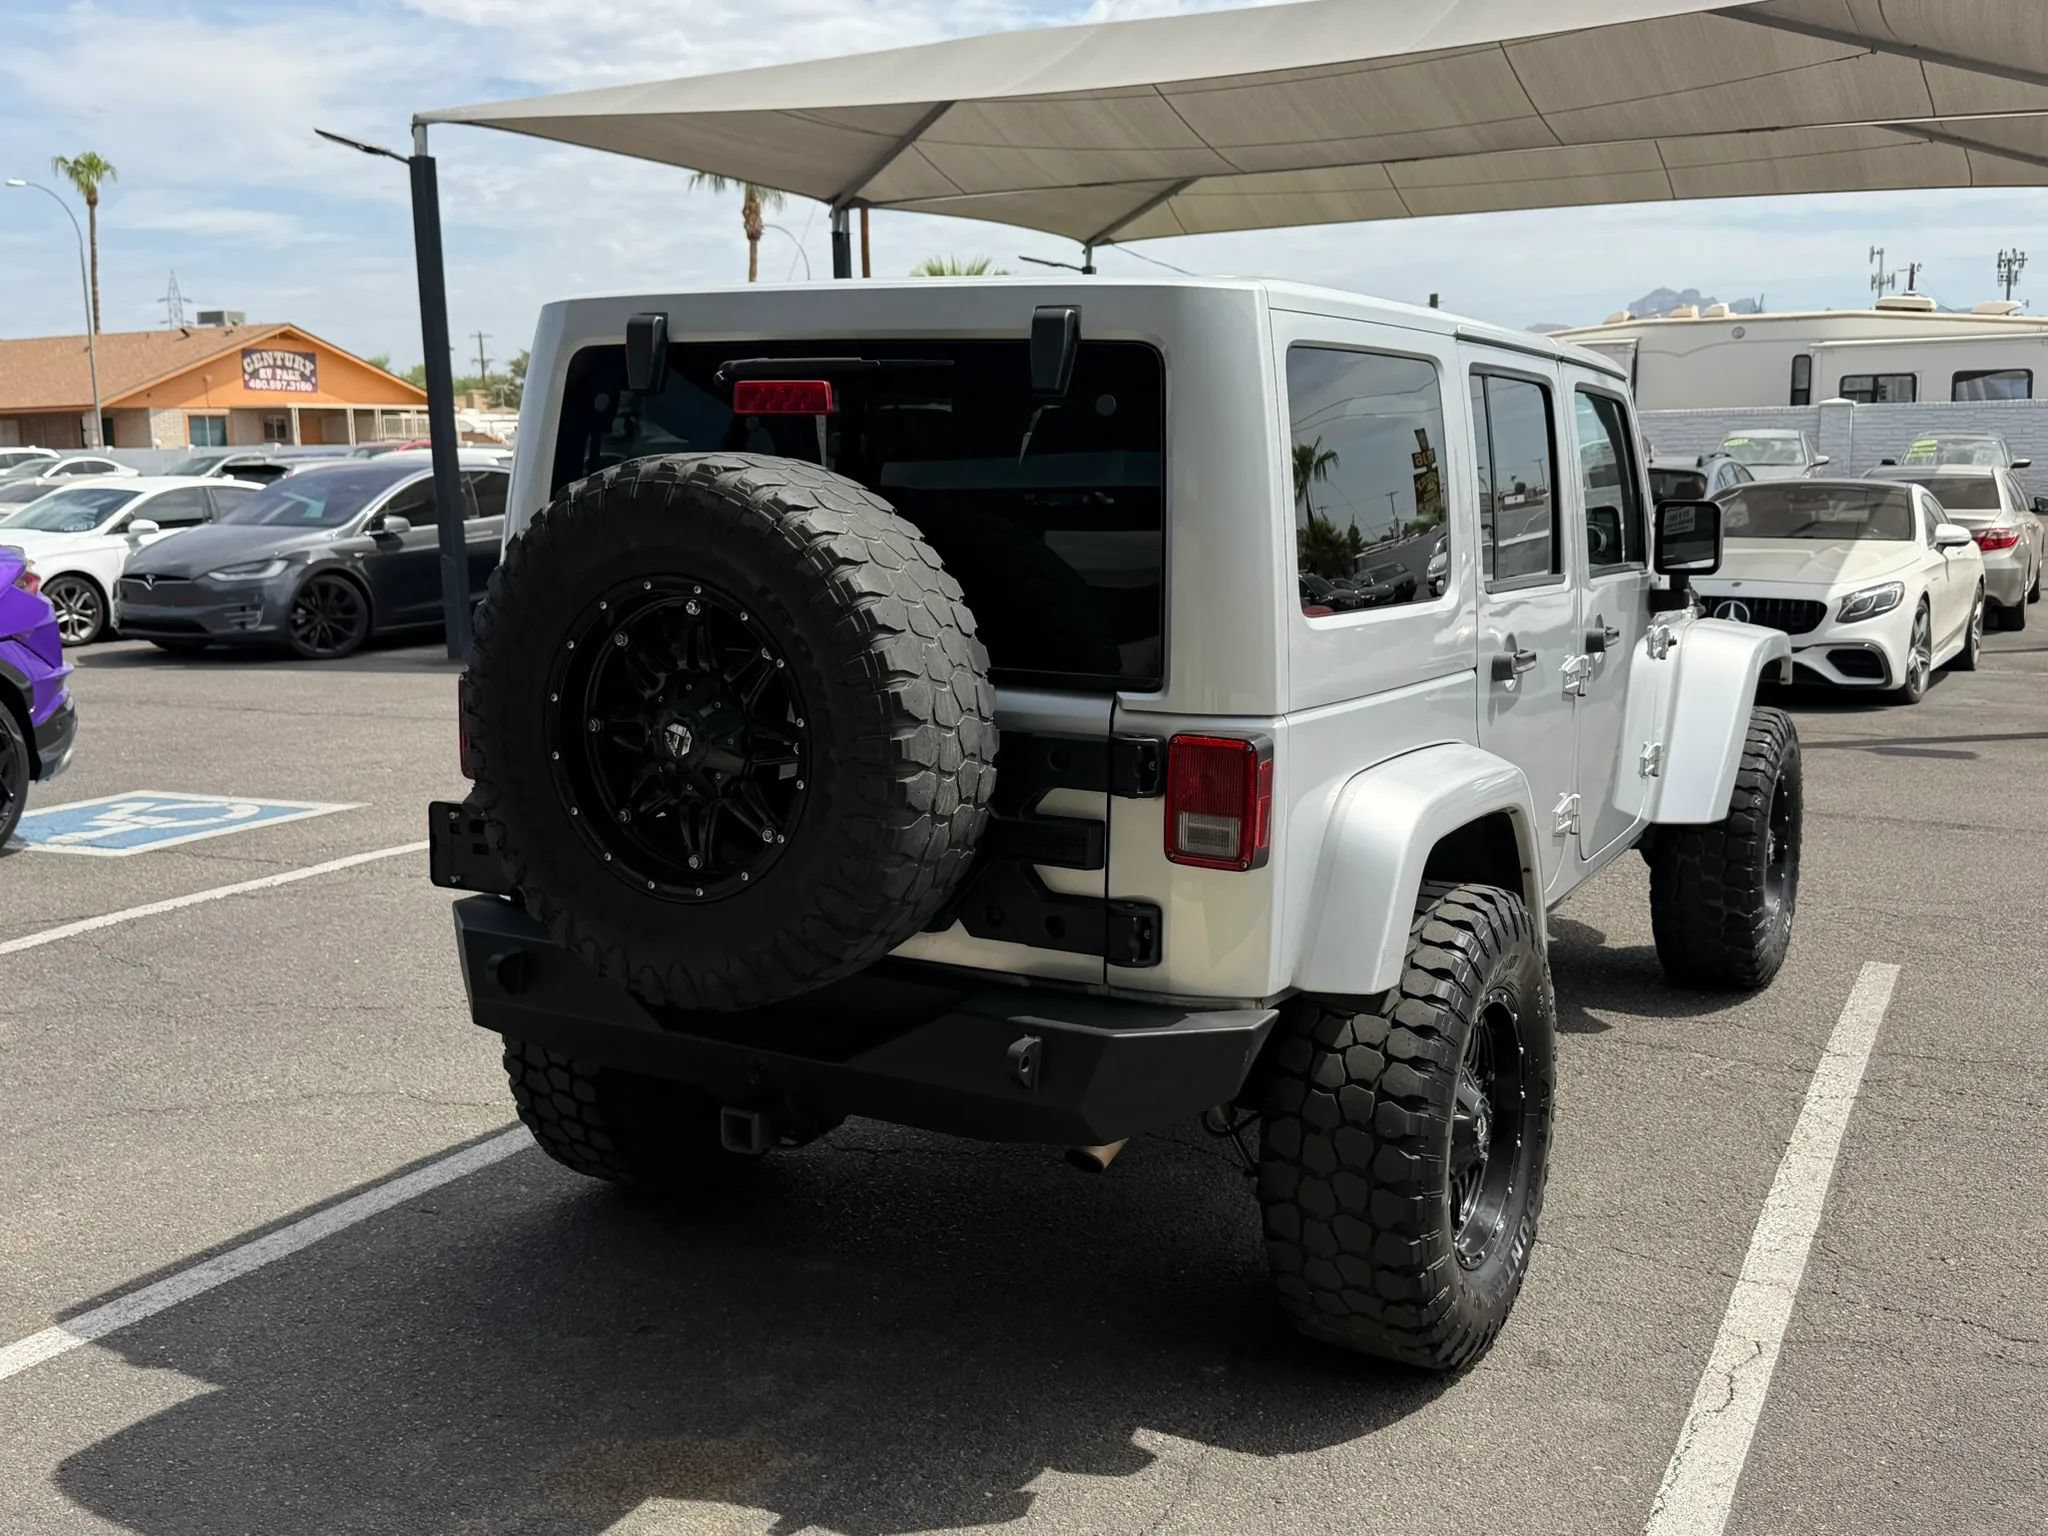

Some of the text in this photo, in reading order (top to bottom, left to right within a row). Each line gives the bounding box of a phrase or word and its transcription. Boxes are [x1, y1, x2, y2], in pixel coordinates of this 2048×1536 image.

[243, 351, 315, 376] CENTURY
[259, 367, 302, 380] RV PARK
